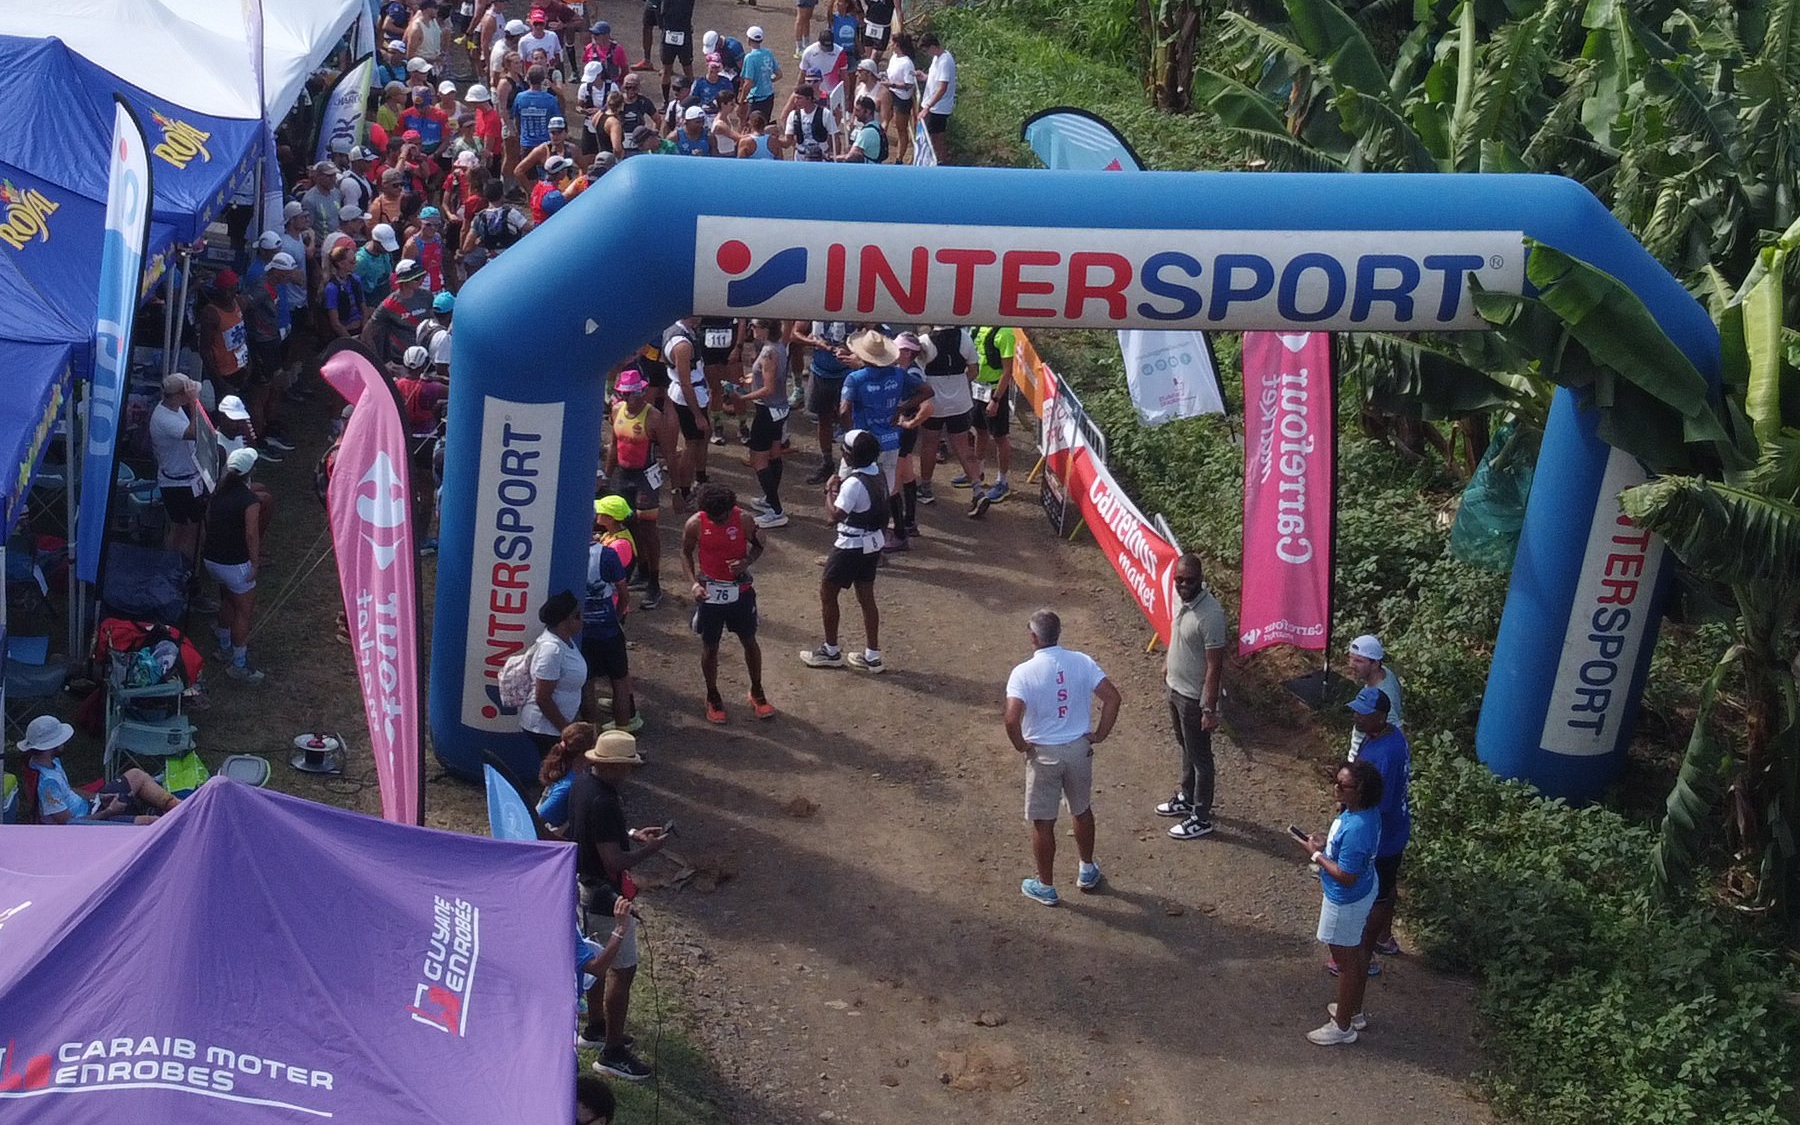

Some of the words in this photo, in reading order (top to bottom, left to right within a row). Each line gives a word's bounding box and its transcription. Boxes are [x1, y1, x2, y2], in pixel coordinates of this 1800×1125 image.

[153, 119, 211, 169] ROYAL
[823, 242, 1485, 323] INTERSPORT
[711, 335, 726, 346] 111
[715, 589, 729, 601] 76
[1118, 551, 1155, 615] market
[424, 895, 451, 981] GUYANE
[58, 1036, 196, 1063] CARAIB
[207, 1045, 334, 1090] MOTER
